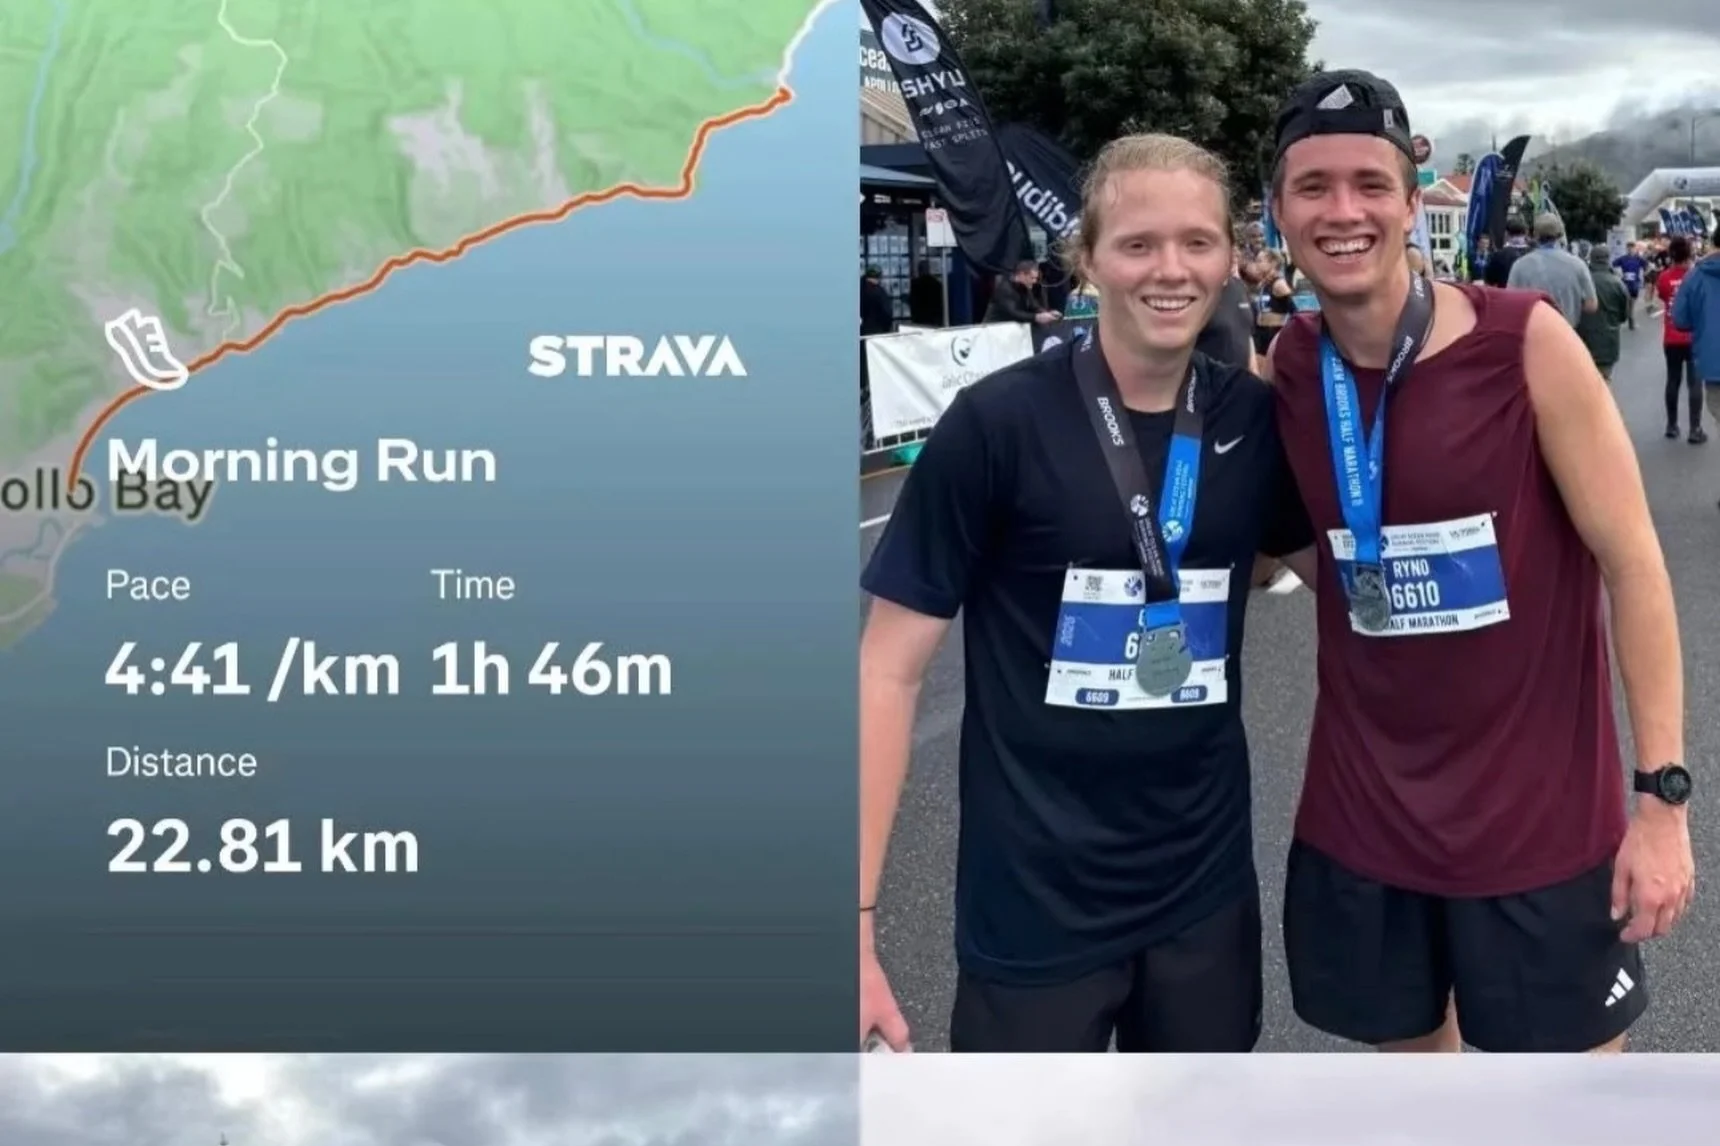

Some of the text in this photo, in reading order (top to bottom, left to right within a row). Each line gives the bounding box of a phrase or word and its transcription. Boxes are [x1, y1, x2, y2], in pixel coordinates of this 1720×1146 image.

[901, 69, 966, 99] SHYU
[1005, 159, 1081, 238] udibl
[1097, 396, 1125, 446] BROOKS
[1340, 418, 1354, 443] HALF
[1343, 445, 1362, 498] MARATHON
[1392, 558, 1430, 578] RYNO
[1391, 581, 1440, 609] 6610
[1387, 615, 1459, 631] ALF MARATHON
[1108, 668, 1134, 682] HALF
